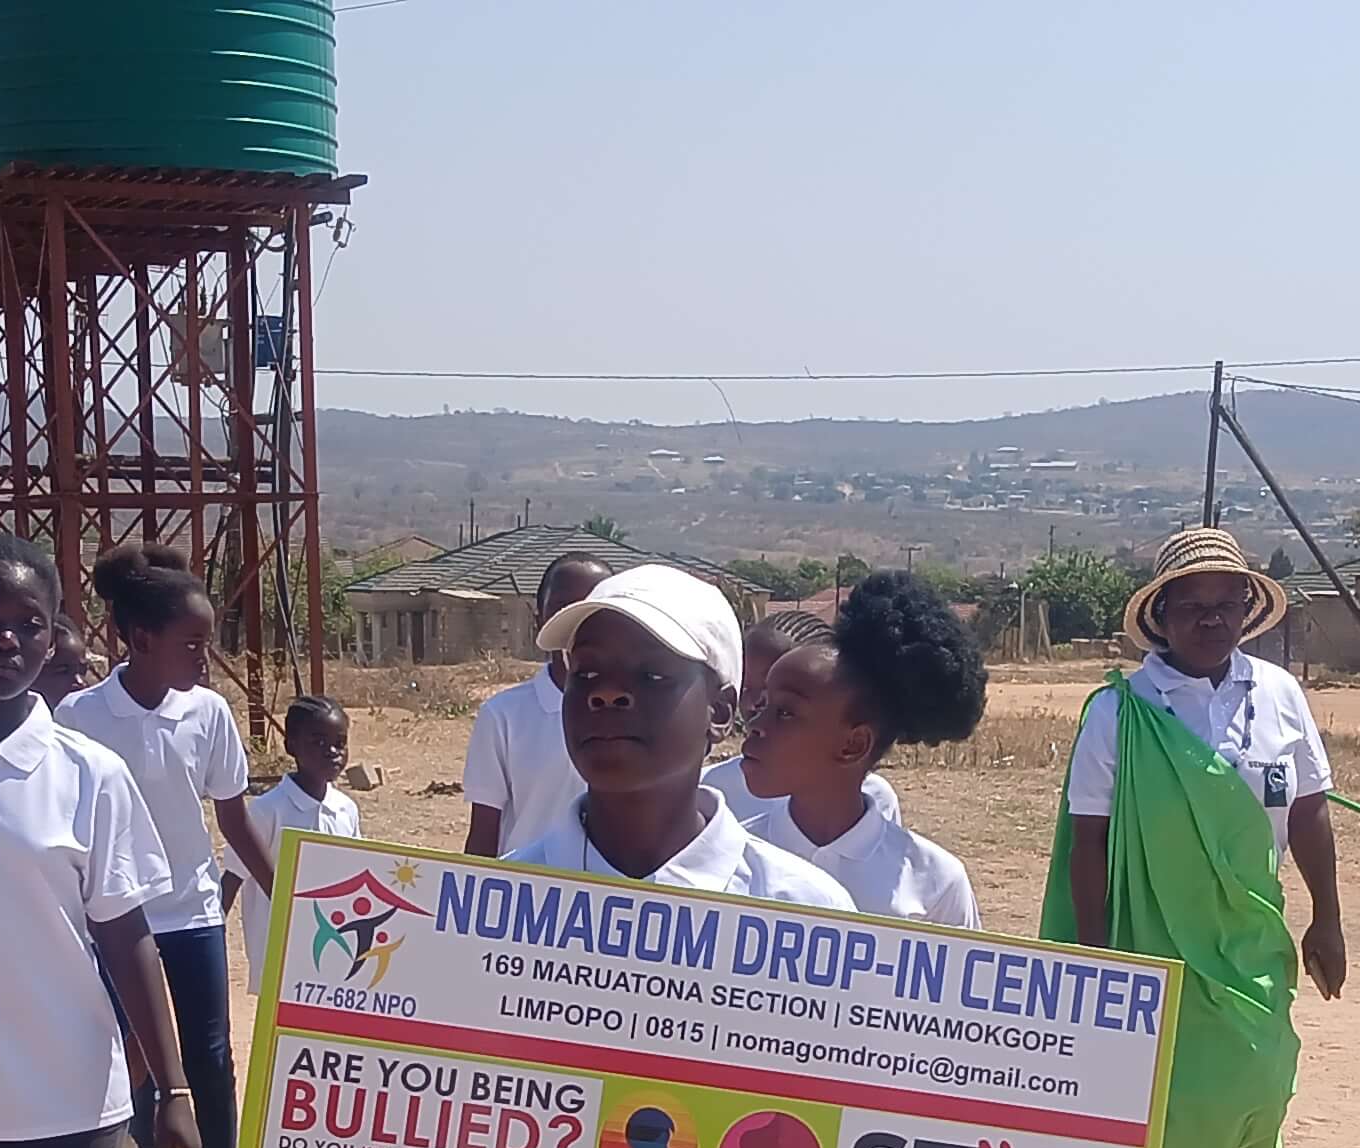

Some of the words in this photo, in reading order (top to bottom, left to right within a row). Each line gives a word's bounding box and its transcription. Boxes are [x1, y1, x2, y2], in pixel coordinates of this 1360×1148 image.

[293, 982, 368, 1011] 177-682
[372, 992, 417, 1018] NPO
[435, 871, 720, 970] NOMAGOM
[732, 914, 948, 1003] DROP-IN
[961, 949, 1162, 1035] CENTER
[481, 952, 524, 977] 169
[532, 959, 703, 1003] MARUATONA
[711, 985, 826, 1020] SECTION
[848, 1005, 1076, 1057] SENWAMOKGOPE
[500, 995, 623, 1031] LIMPOPO
[645, 1017, 704, 1043] 0815
[726, 1029, 1080, 1097] nomagomdropic@gmail.com
[288, 1048, 364, 1084] ARE
[378, 1058, 458, 1096] YOU
[471, 1072, 586, 1113] BEING
